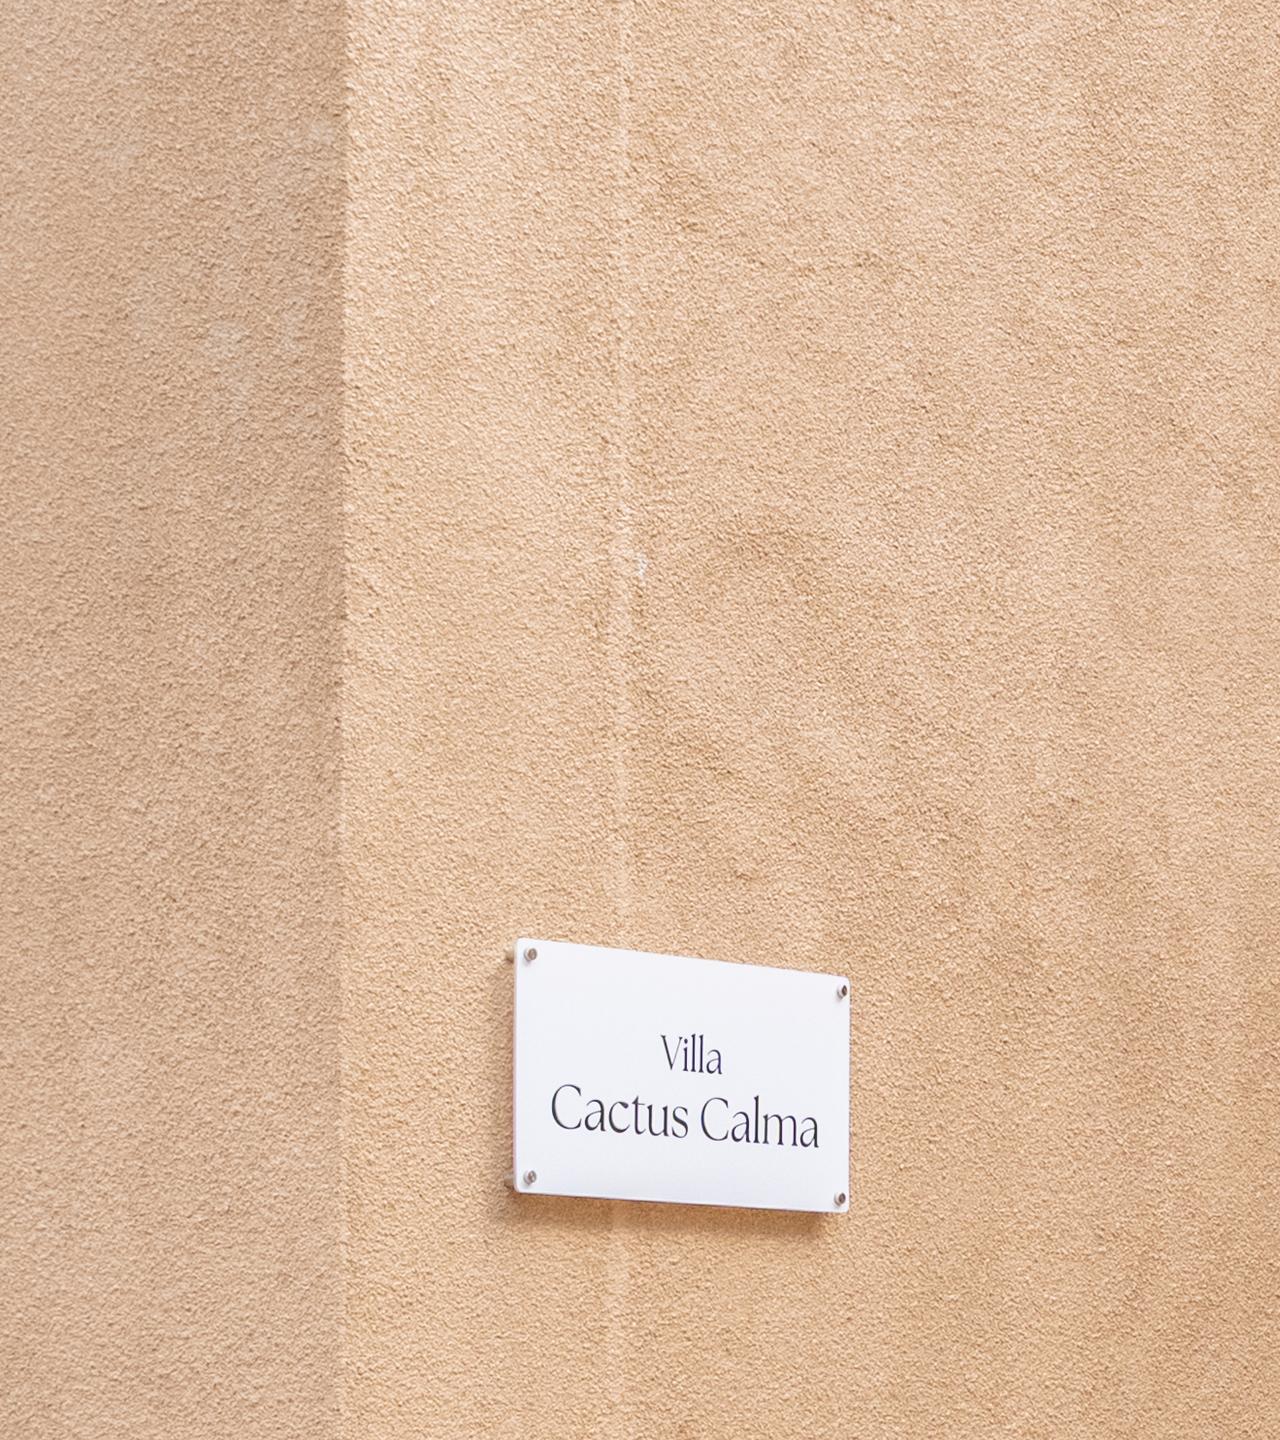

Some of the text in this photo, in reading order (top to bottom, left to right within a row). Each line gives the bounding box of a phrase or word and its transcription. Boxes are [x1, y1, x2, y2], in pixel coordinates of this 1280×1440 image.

[660, 1033, 723, 1075] Villa
[551, 1084, 820, 1148] Cactus Calma
